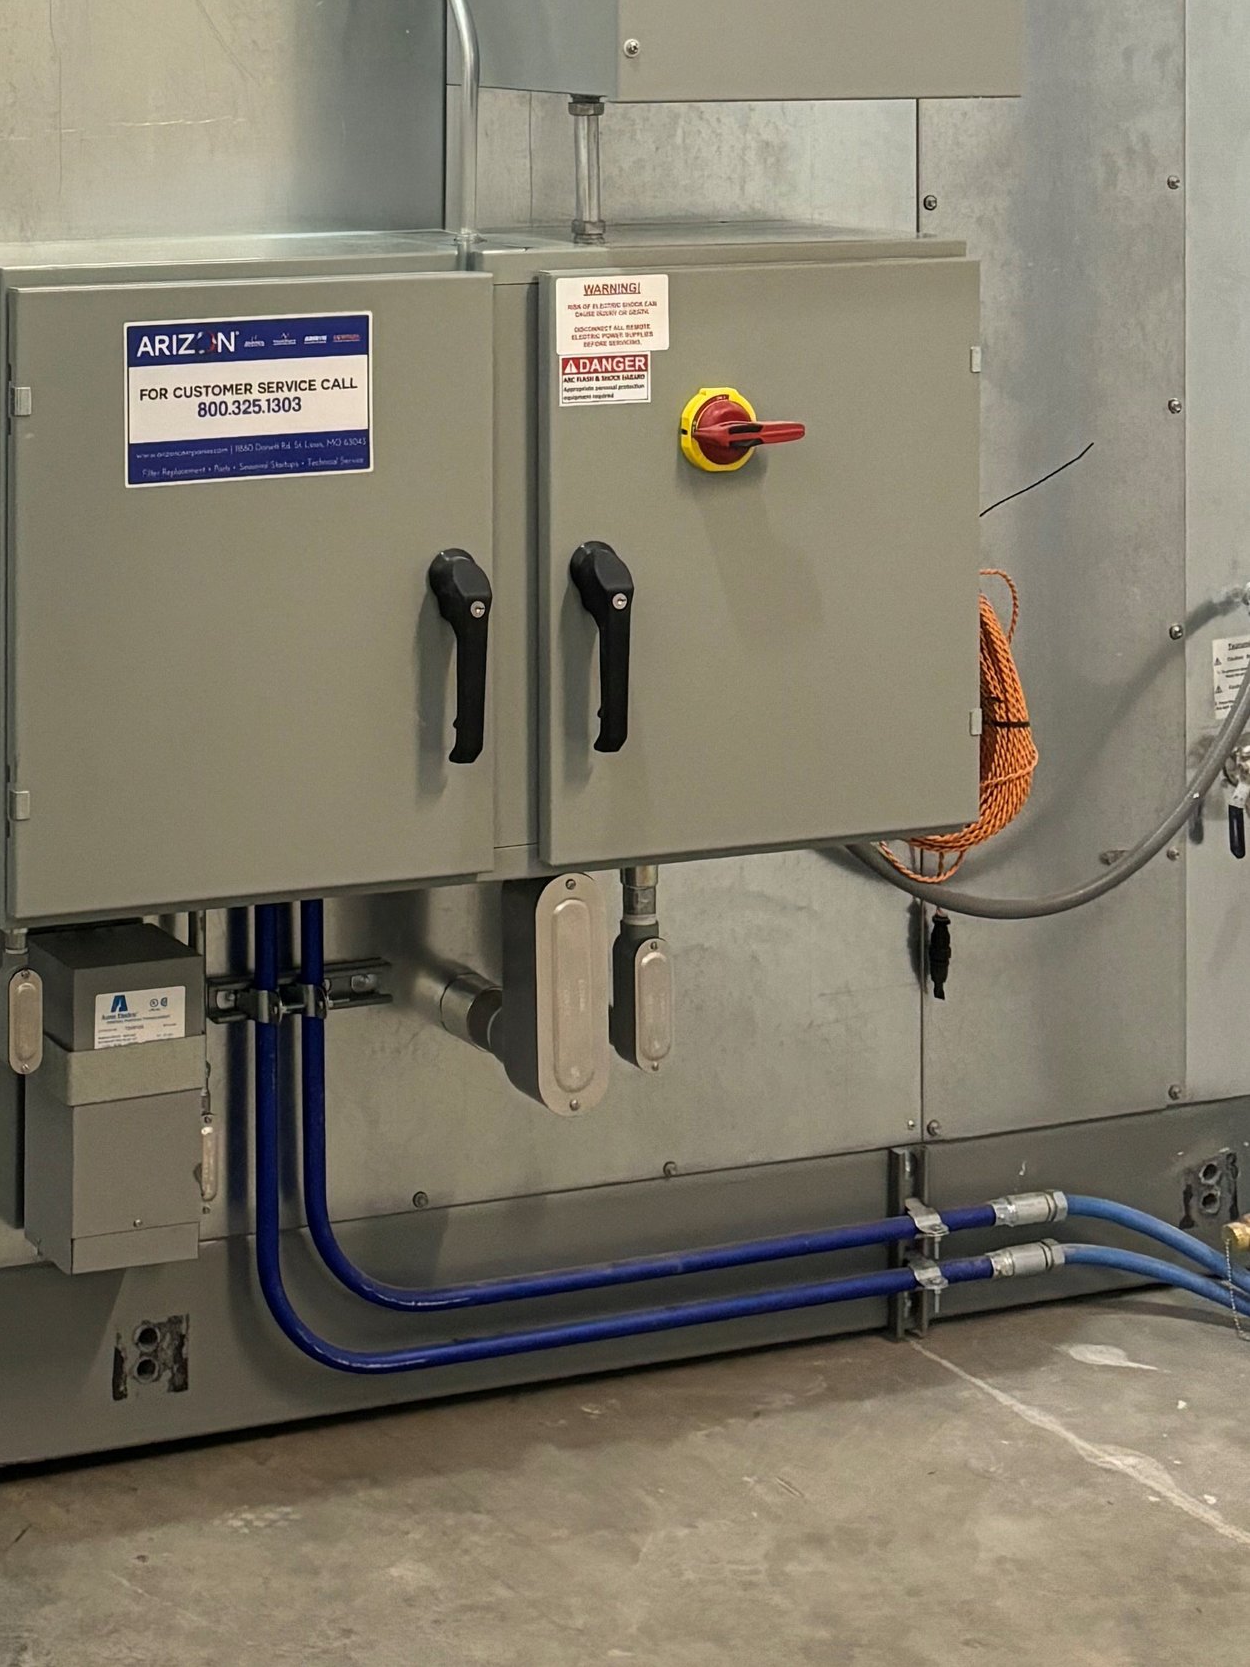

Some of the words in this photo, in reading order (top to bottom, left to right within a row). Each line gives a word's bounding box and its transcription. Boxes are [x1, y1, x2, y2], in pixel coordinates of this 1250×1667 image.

[579, 356, 647, 373] DANGER
[139, 387, 168, 401] FOR
[173, 382, 253, 399] CUSTOMER
[257, 379, 317, 394] SERVICE
[320, 377, 358, 391] CALL
[197, 396, 302, 418] 800.325.1303
